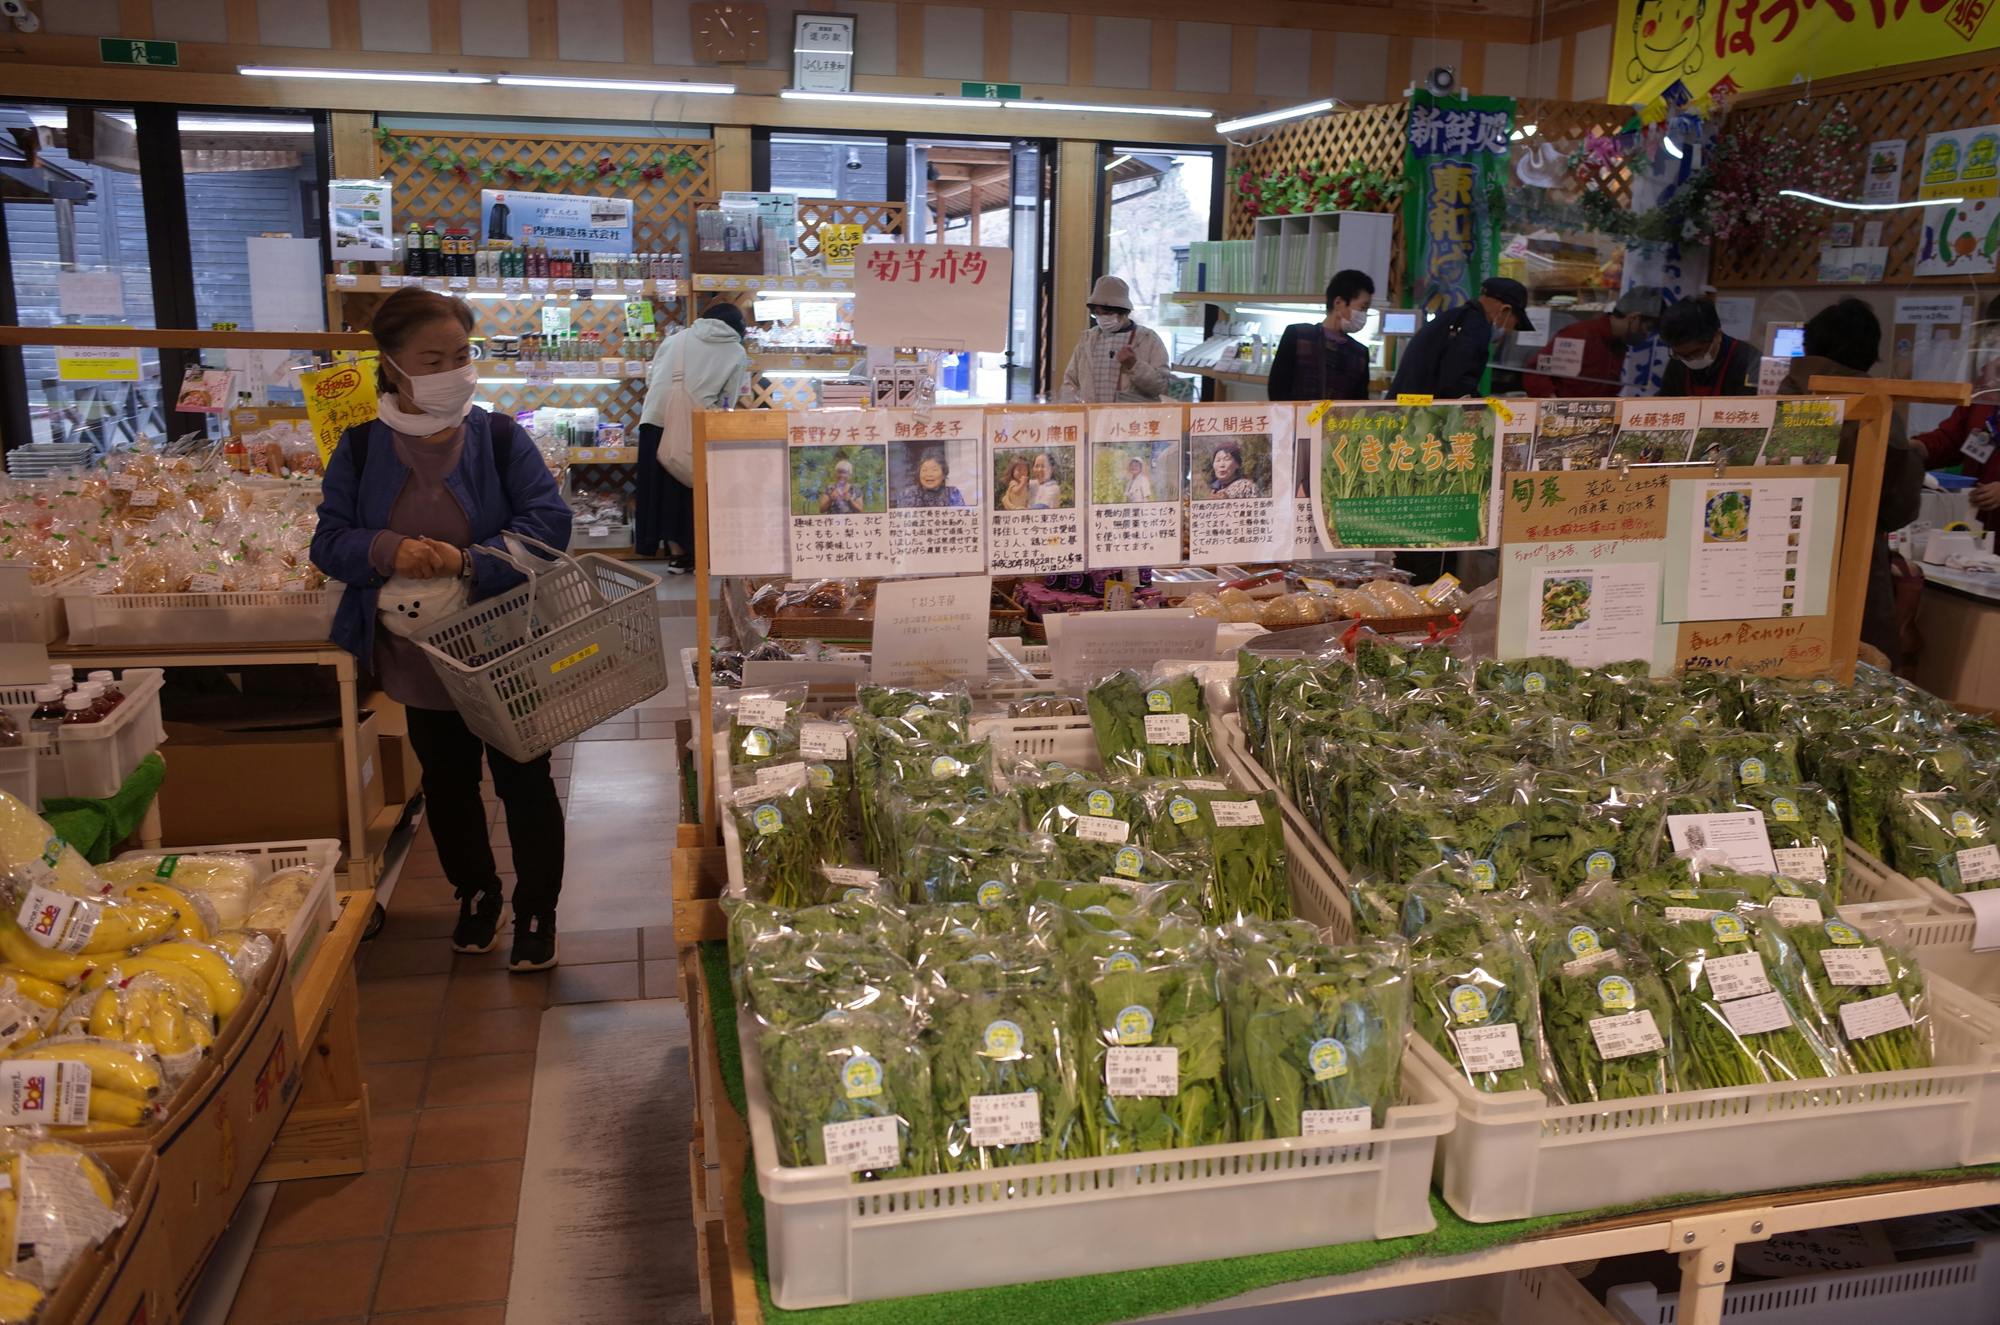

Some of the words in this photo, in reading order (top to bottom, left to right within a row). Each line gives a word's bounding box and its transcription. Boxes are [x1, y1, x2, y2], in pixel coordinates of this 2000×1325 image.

[895, 421, 962, 438] 朝倉孝子
[1190, 415, 1270, 434] 佐久間岩子
[1628, 411, 1686, 427] 佐藤浩明
[790, 426, 881, 443] 菅野タキ子
[1332, 432, 1477, 476] くきたち菜
[1511, 477, 1567, 512] 旬菜
[34, 904, 58, 936] Dole
[23, 1076, 41, 1111] Dole
